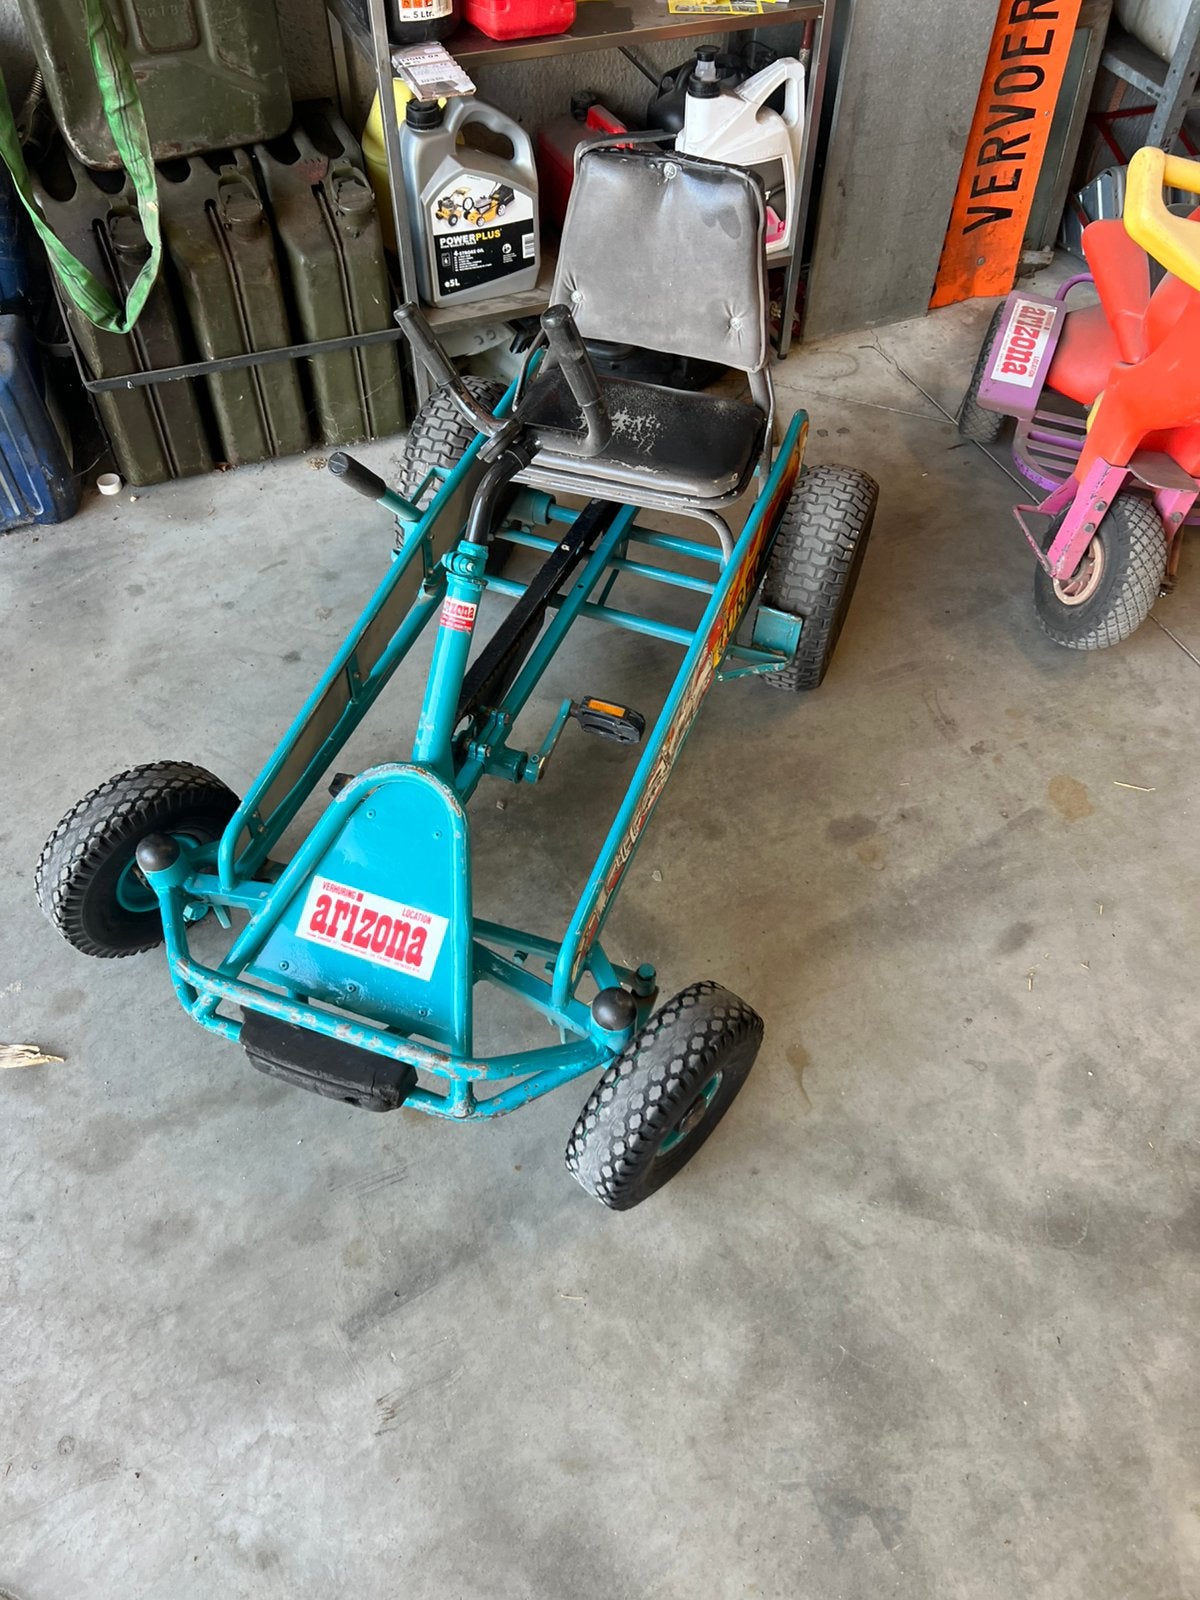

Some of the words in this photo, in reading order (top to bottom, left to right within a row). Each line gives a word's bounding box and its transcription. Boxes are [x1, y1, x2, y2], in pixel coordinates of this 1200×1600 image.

[413, 10, 419, 19] 5
[420, 10, 435, 18] Ltr.
[962, 0, 1059, 235] VERVOER
[440, 229, 501, 246] POWERPLUS
[1001, 305, 1049, 376] arizona
[322, 881, 357, 900] VERHURING
[401, 908, 432, 925] LOCATION
[309, 892, 428, 967] arizona
